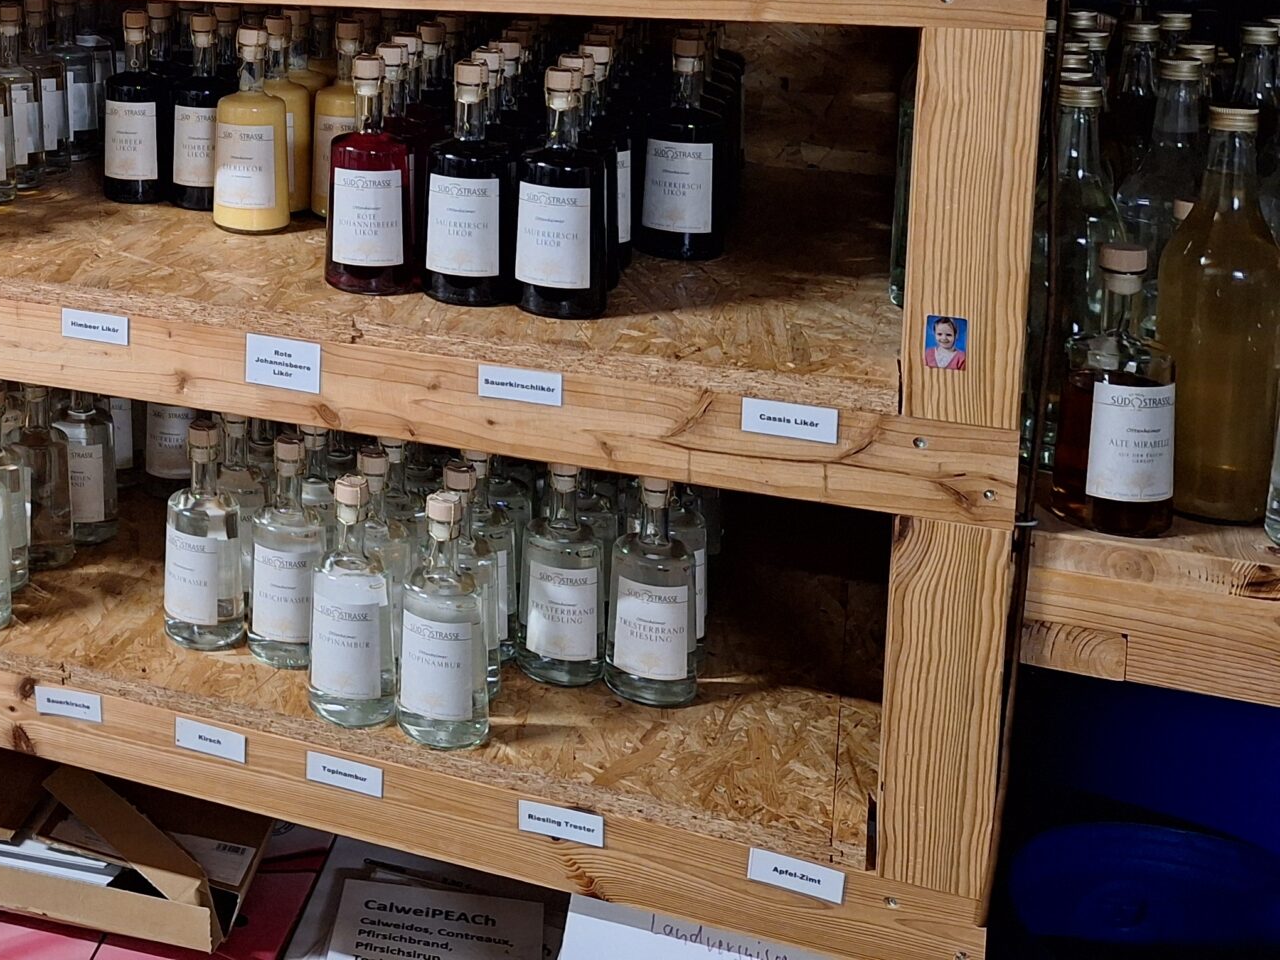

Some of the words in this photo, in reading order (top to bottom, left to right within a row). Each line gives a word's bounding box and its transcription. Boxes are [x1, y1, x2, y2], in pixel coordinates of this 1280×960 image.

[675, 150, 703, 160] STRASSE
[365, 178, 393, 188] STRASSE
[460, 185, 489, 196] STRASSE
[548, 195, 578, 206] STRASSE
[70, 320, 99, 331] Himbeer
[101, 323, 120, 334] Likör
[273, 349, 292, 359] Rote
[254, 356, 312, 372] Johannisbeere
[272, 368, 294, 379] Likör
[483, 377, 557, 394] Sauerkirschlikör
[1111, 395, 1131, 406] SÜD
[1143, 396, 1171, 408] STRASSE
[758, 412, 792, 425] Cassis
[793, 416, 820, 429] Likör
[1108, 439, 1129, 449] ALTE
[282, 558, 308, 570] STRASSE
[561, 575, 589, 586] STRASSE
[650, 593, 679, 604] STRASSE
[341, 610, 370, 621] STRASSE
[431, 629, 461, 640] STRASSE
[45, 696, 91, 711] Sauerkirsche
[197, 733, 222, 746] Kirsch
[320, 764, 368, 784] Topinambur
[526, 812, 563, 828] Riesling
[563, 819, 596, 834] Trester
[771, 864, 822, 886] Apfel-Zimt
[363, 899, 497, 927] CalweiPEACh
[360, 917, 433, 936] Calweidos,
[437, 927, 514, 948] Contreaux,
[357, 928, 453, 952] Pfirsichbrand,
